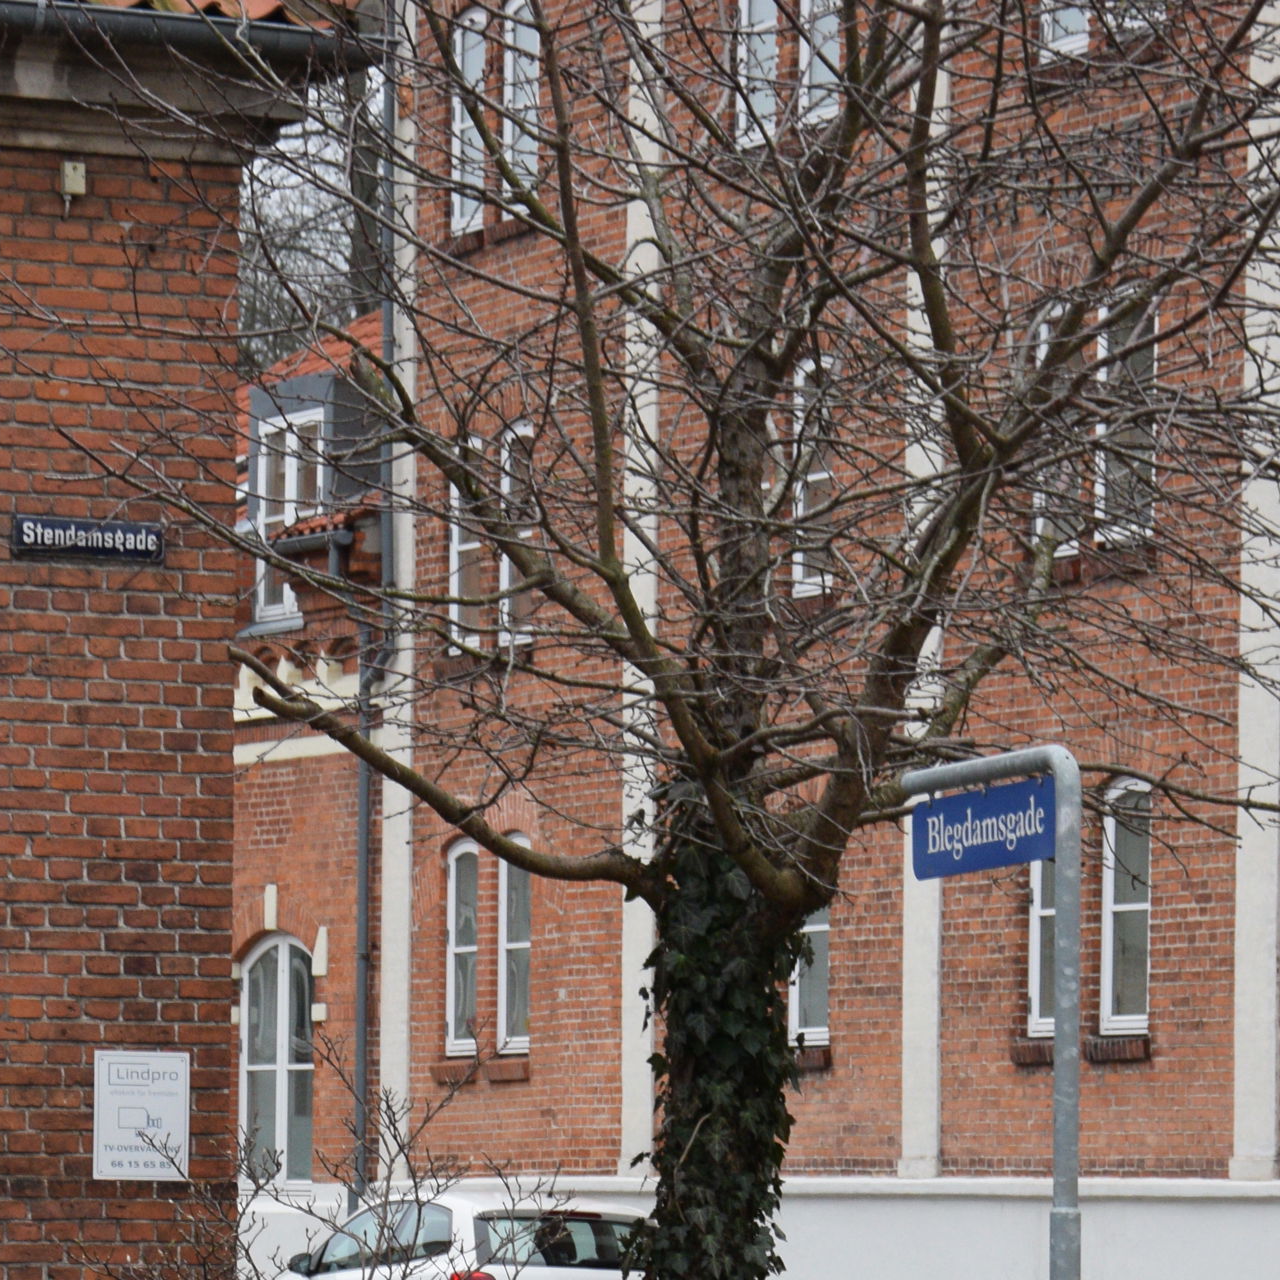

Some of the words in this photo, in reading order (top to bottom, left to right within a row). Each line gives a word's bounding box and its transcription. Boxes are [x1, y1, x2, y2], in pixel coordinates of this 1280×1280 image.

[22, 521, 158, 551] Stendamsgade
[927, 795, 1045, 860] Blegdamsgade
[117, 1067, 179, 1083] Lindpro
